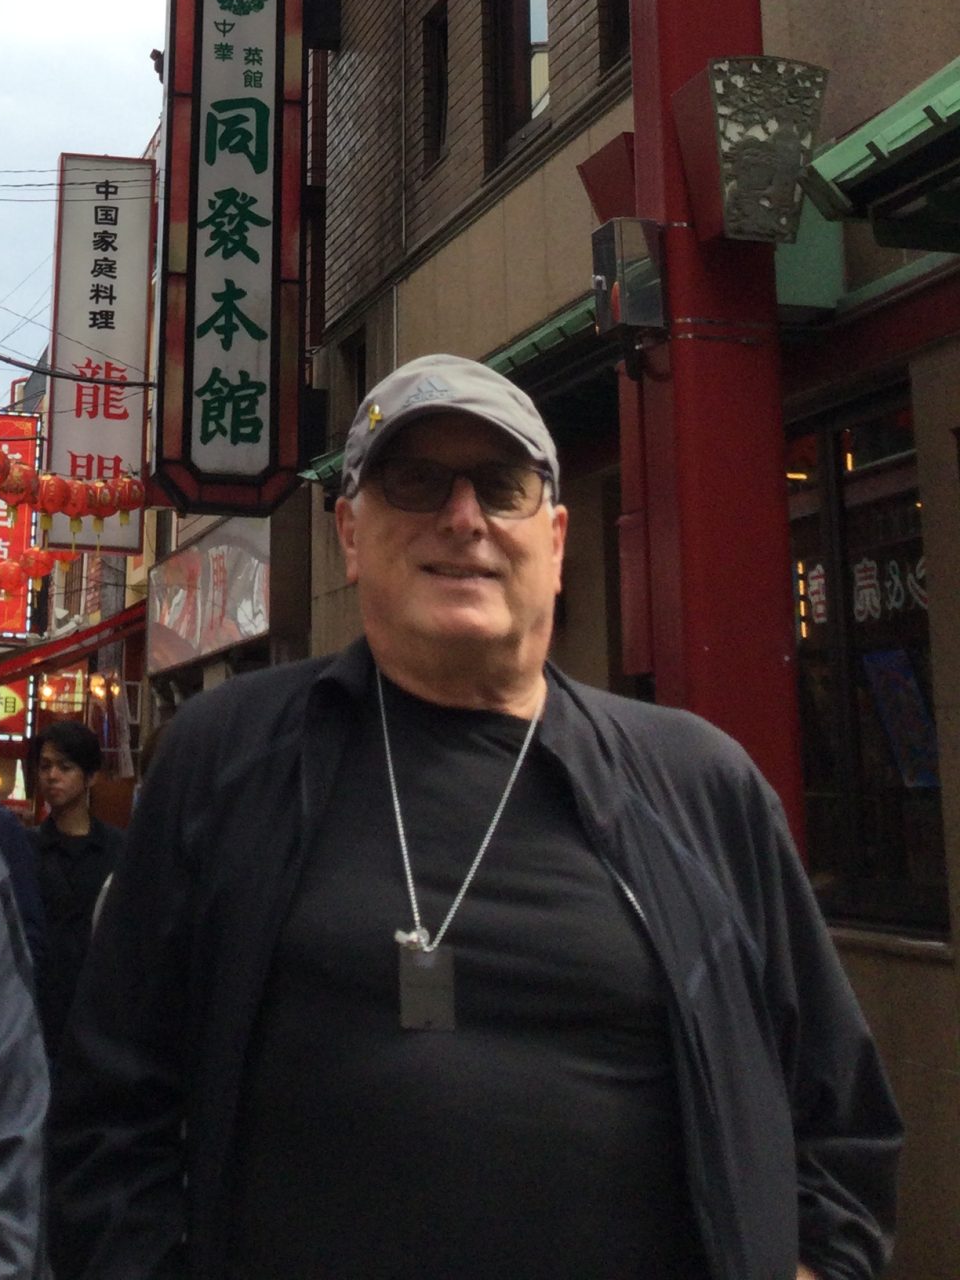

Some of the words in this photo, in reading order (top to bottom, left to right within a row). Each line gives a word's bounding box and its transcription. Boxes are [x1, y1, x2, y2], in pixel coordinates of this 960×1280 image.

[213, 19, 236, 62] 中華
[243, 47, 264, 89] 菜館
[88, 179, 120, 331] 中国家庭料理
[194, 97, 272, 447] 同發本館
